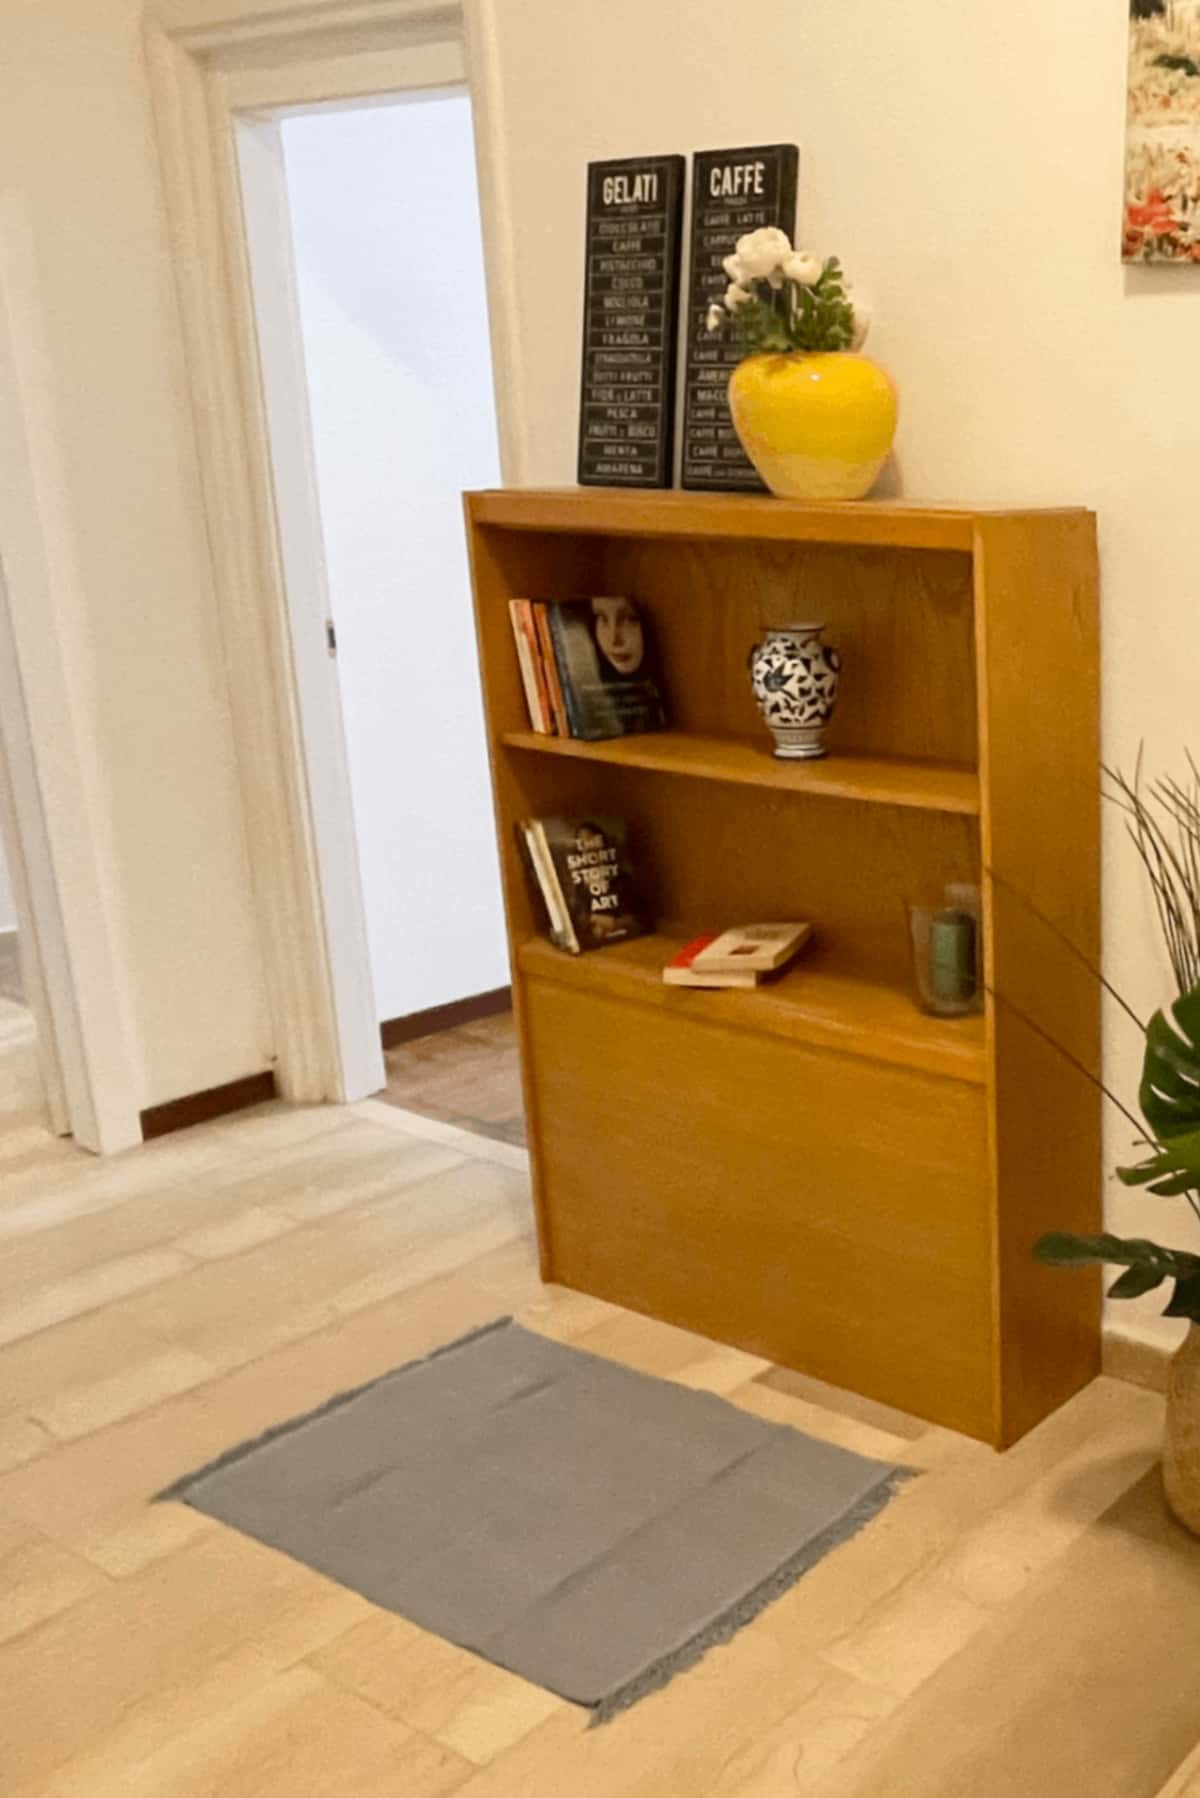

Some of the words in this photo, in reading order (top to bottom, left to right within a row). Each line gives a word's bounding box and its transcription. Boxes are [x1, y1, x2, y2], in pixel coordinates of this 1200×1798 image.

[603, 174, 658, 205] GELATI
[602, 333, 648, 345] FRAGOLA
[576, 834, 603, 850] THE
[568, 848, 616, 870] SHORT
[571, 864, 618, 885] STORY
[589, 880, 609, 896] OF
[591, 894, 618, 912] ART
